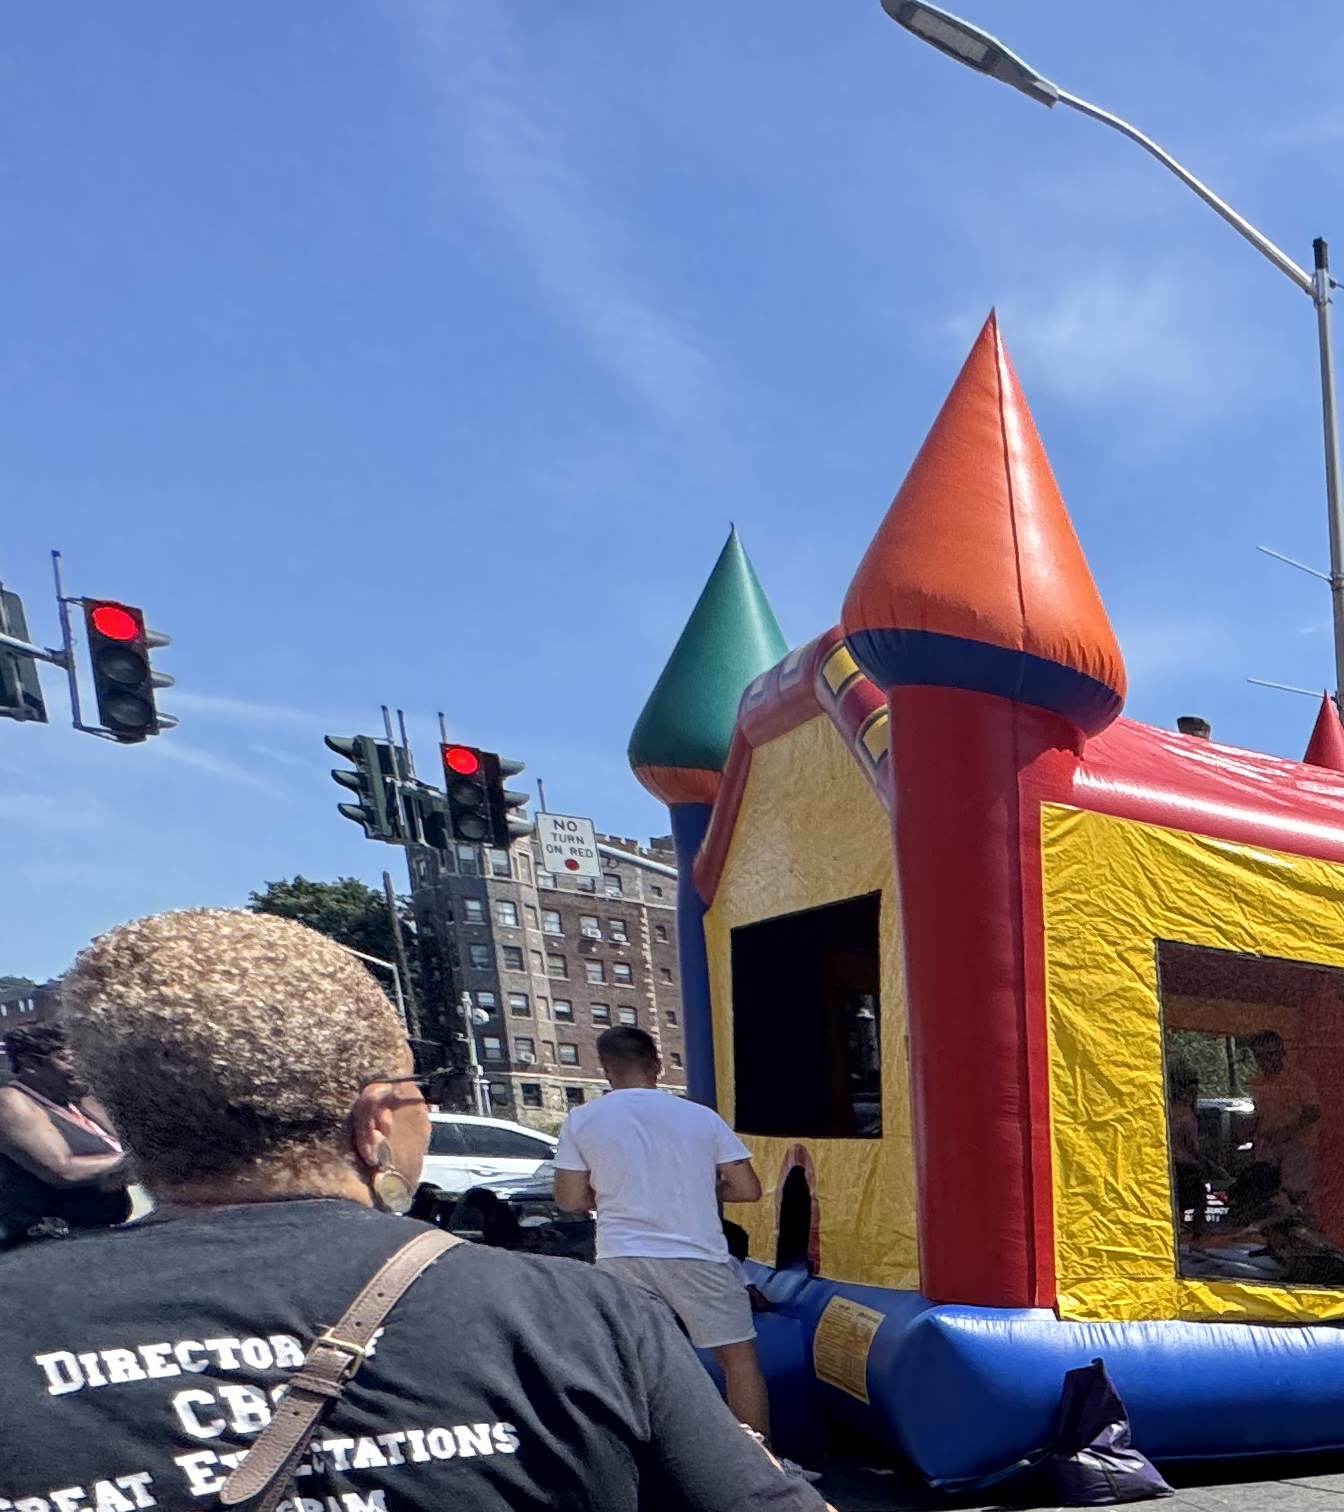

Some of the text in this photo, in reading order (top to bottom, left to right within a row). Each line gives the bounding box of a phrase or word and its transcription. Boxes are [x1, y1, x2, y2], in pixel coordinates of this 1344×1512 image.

[553, 819, 578, 832] NO
[550, 832, 585, 845] TURN
[546, 843, 594, 858] ON RED
[35, 1333, 306, 1397] DIRECTOR
